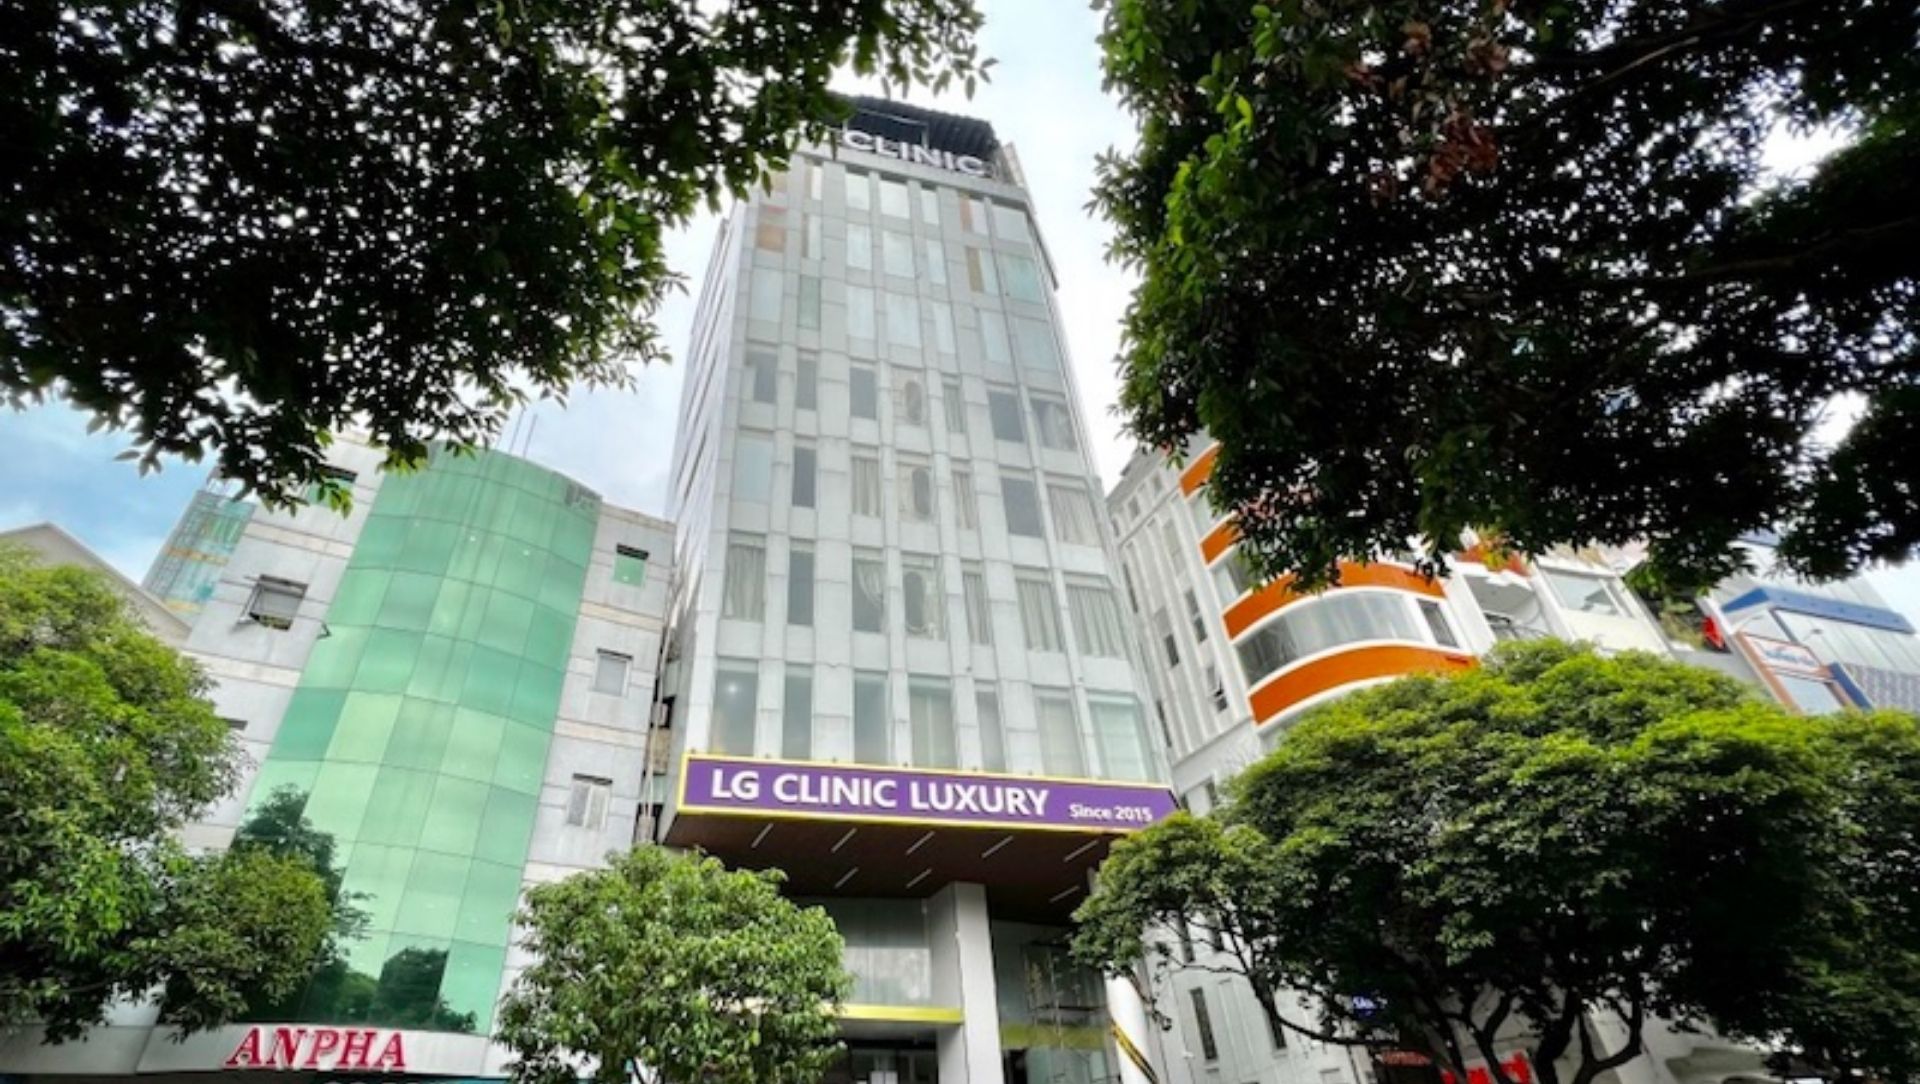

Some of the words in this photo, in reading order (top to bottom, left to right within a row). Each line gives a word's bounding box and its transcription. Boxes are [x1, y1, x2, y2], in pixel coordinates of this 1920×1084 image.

[843, 129, 986, 176] CLINIC
[711, 768, 760, 800] LG
[772, 773, 897, 808] CLINIC
[910, 780, 1049, 816] LUXURY
[1069, 803, 1112, 820] Since
[1114, 805, 1153, 822] 2015
[225, 1026, 407, 1068] ANPHA
